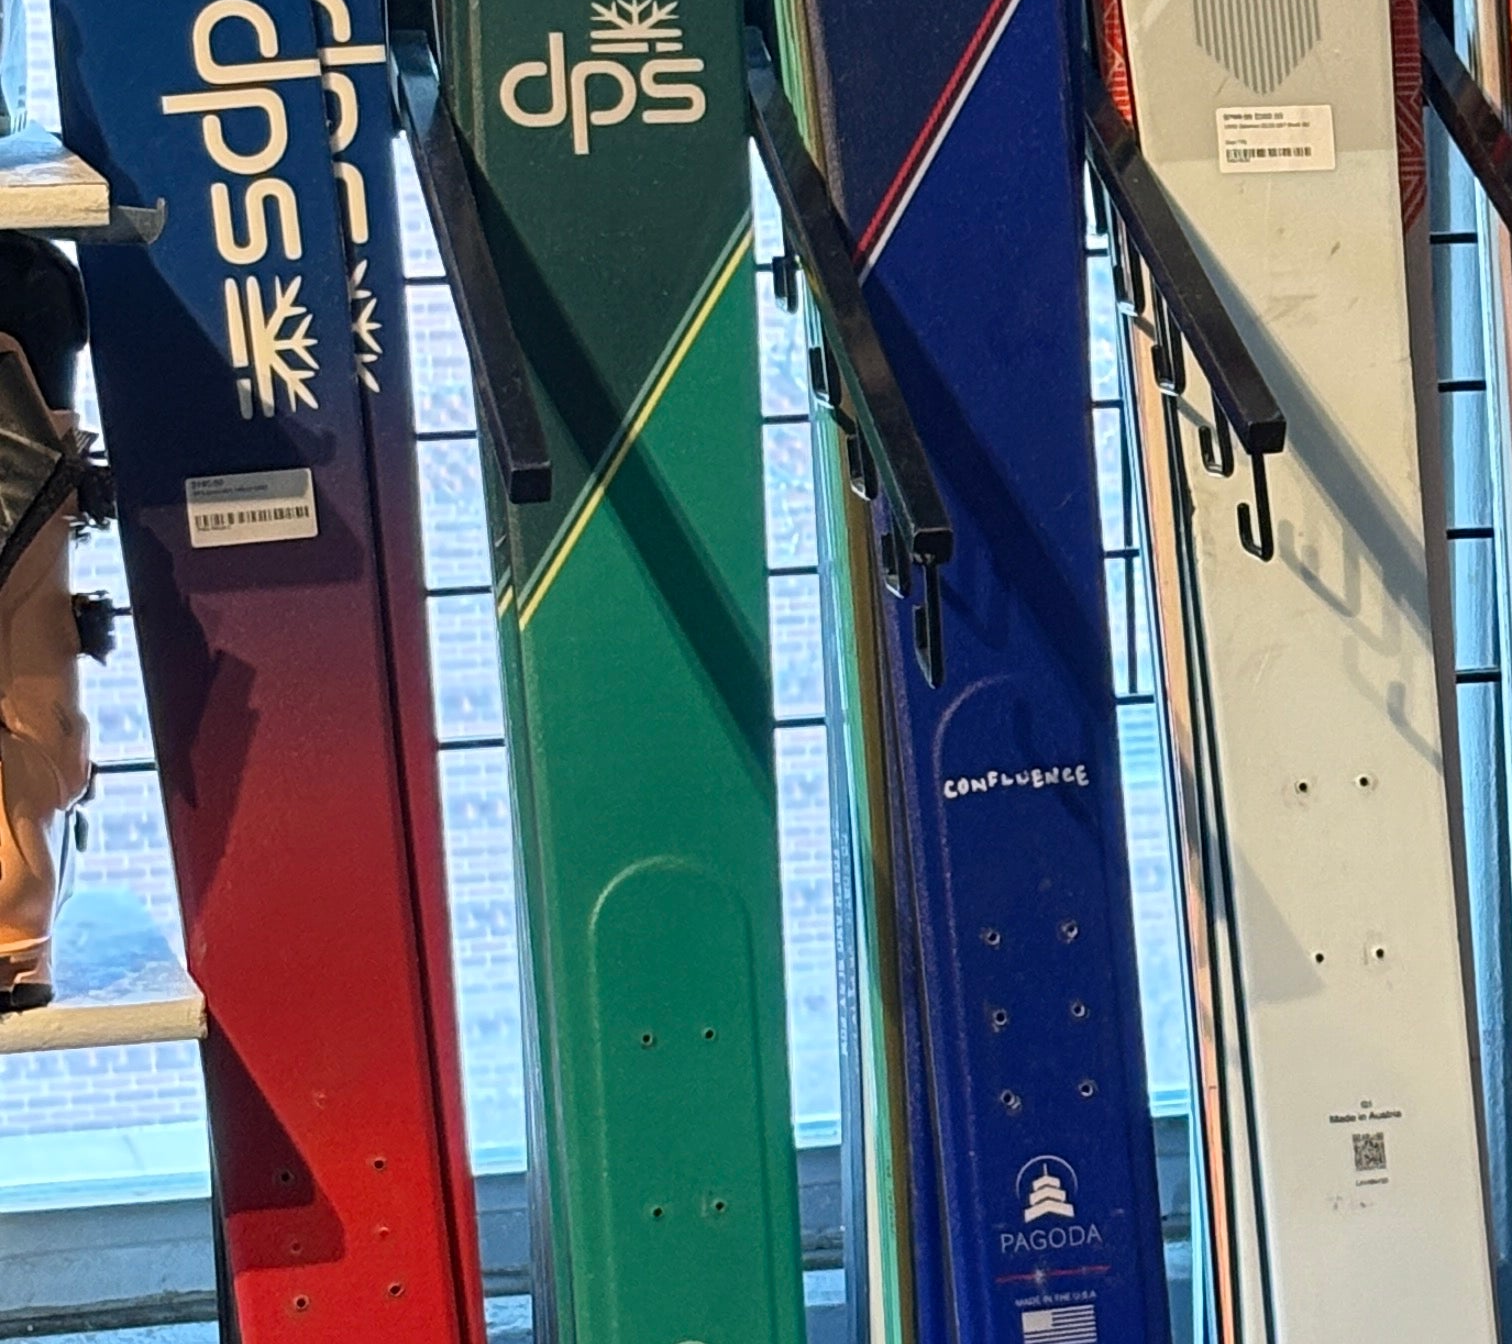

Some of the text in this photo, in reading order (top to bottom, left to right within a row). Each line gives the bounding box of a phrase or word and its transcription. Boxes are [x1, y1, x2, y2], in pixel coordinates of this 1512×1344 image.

[500, 32, 705, 155] dps
[943, 763, 1090, 799] CONFLUENCE
[1329, 1115, 1356, 1123] Made
[1369, 1110, 1402, 1120] Austria
[1000, 1223, 1103, 1254] PAGODA
[1043, 1295, 1052, 1303] IN
[1054, 1292, 1070, 1301] THE
